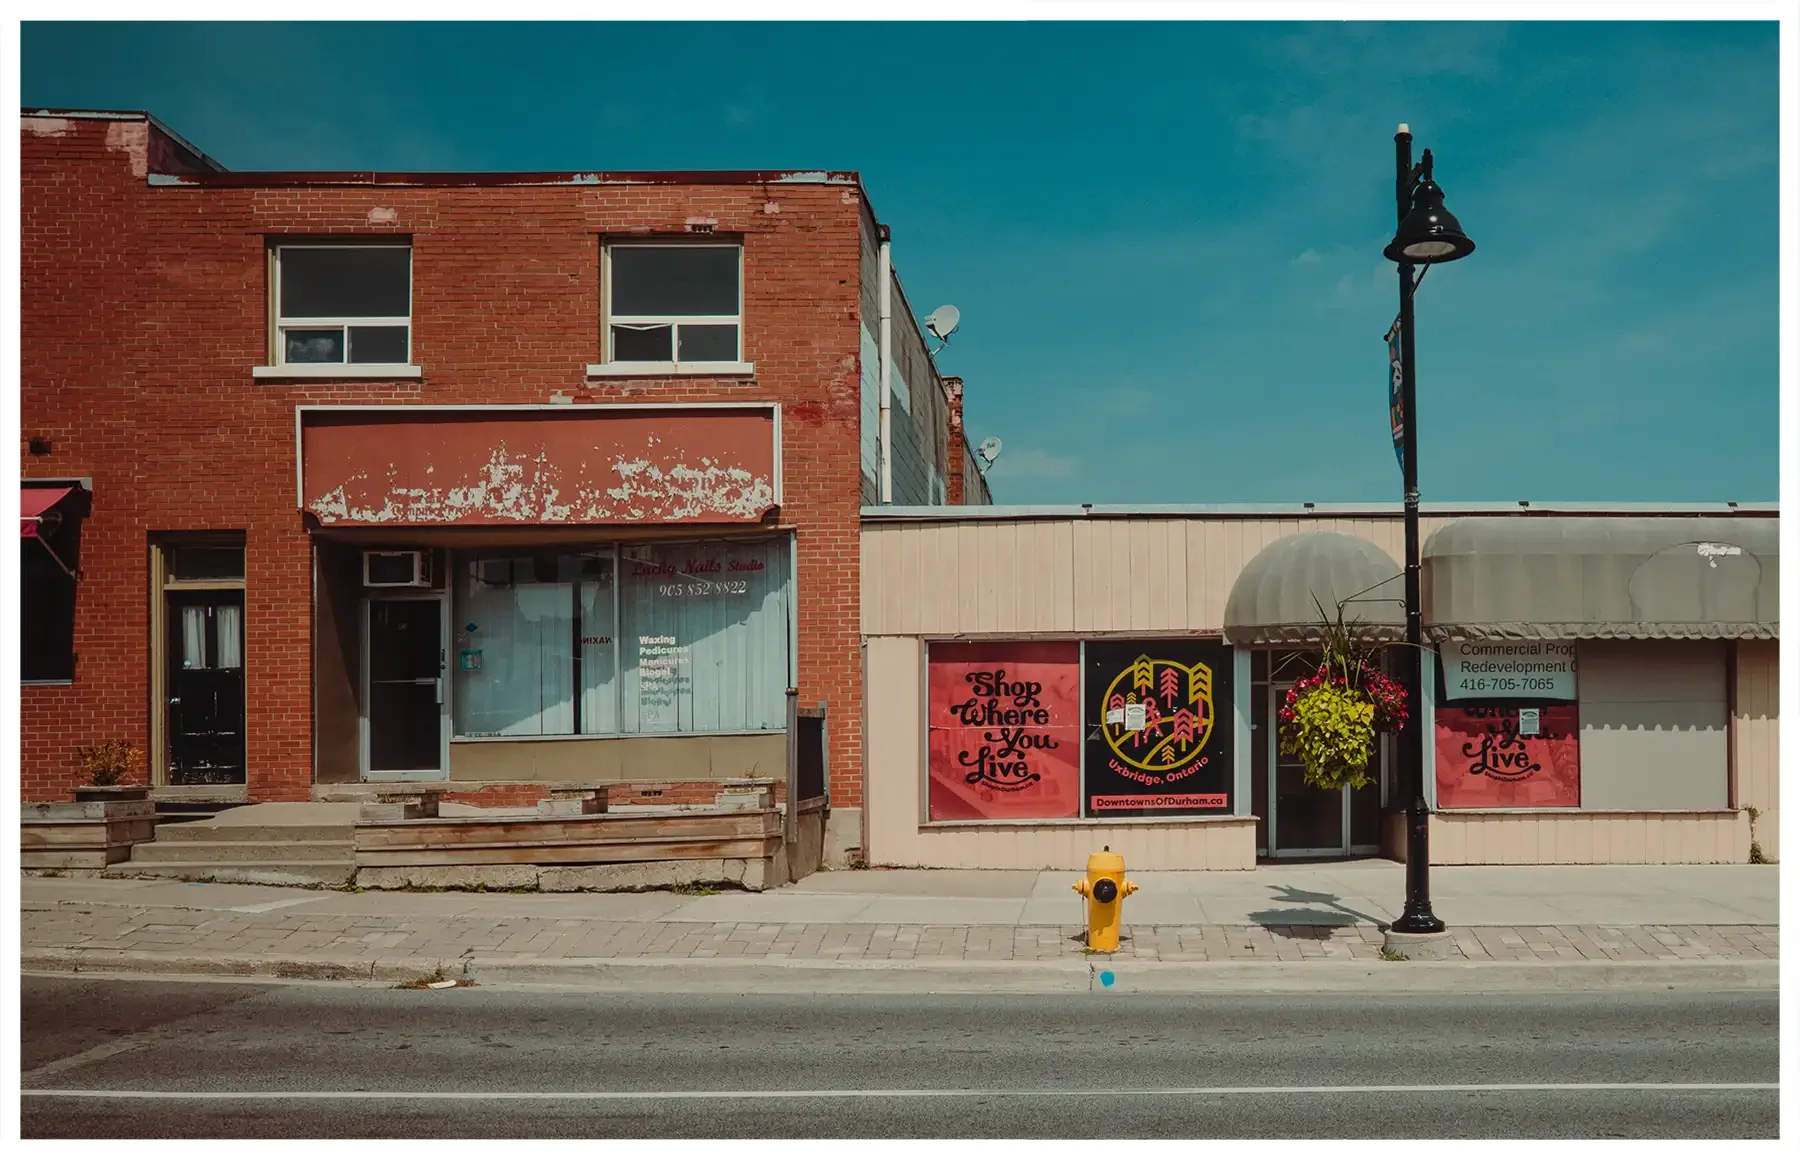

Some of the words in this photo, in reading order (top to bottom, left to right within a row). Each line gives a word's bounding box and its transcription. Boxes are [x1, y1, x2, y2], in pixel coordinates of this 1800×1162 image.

[679, 559, 721, 574] Nails
[727, 559, 764, 572] Studio
[660, 584, 682, 596] 905
[687, 583, 711, 595] 852
[715, 581, 747, 594] 8822
[639, 635, 676, 645] Waxing
[639, 646, 689, 656] Pedicures
[1460, 643, 1541, 656] Commercial
[639, 658, 691, 666] Manicures
[1461, 660, 1566, 675] Redevelopment
[965, 669, 1042, 707] Shop
[1460, 678, 1554, 690] 416-705-7065
[950, 698, 1049, 726] Where
[984, 727, 1059, 760] You
[1462, 736, 1541, 775] Live
[958, 746, 1041, 784] Live
[1108, 759, 1164, 785] Uxbridge,
[1166, 757, 1209, 782] Ontario
[1096, 797, 1223, 807] DowntownsOfDurham.ca
